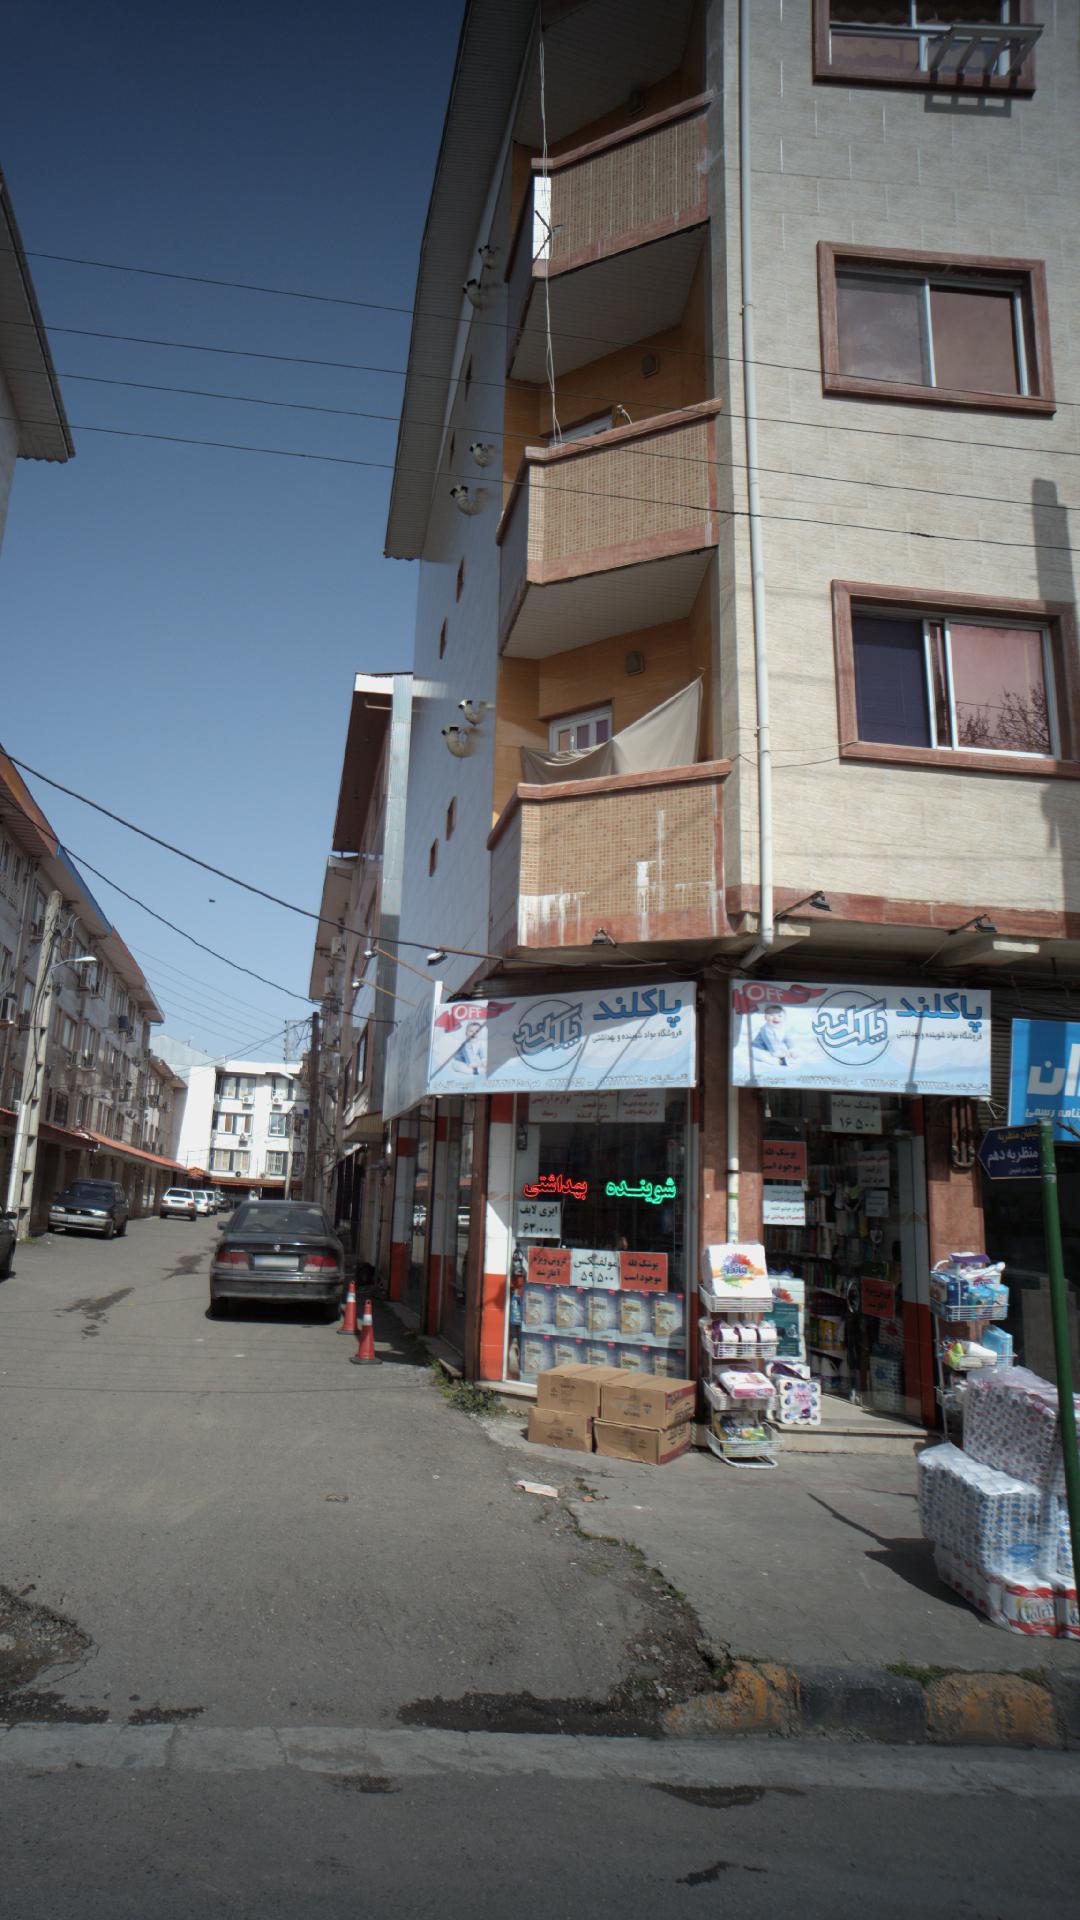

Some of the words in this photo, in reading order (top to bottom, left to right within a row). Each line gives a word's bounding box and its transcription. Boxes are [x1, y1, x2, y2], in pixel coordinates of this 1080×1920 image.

[747, 985, 784, 1001] OFF
[454, 1005, 482, 1020] OFF
[593, 988, 681, 1028] پاکلند
[896, 992, 982, 1034] پاکلند
[987, 1149, 1006, 1168] دهم
[1006, 1146, 1038, 1163] منظریه
[524, 1174, 588, 1200] بهداشتی
[605, 1177, 677, 1204] شوینده
[520, 1205, 537, 1217] لایف
[539, 1206, 558, 1218] ایزی
